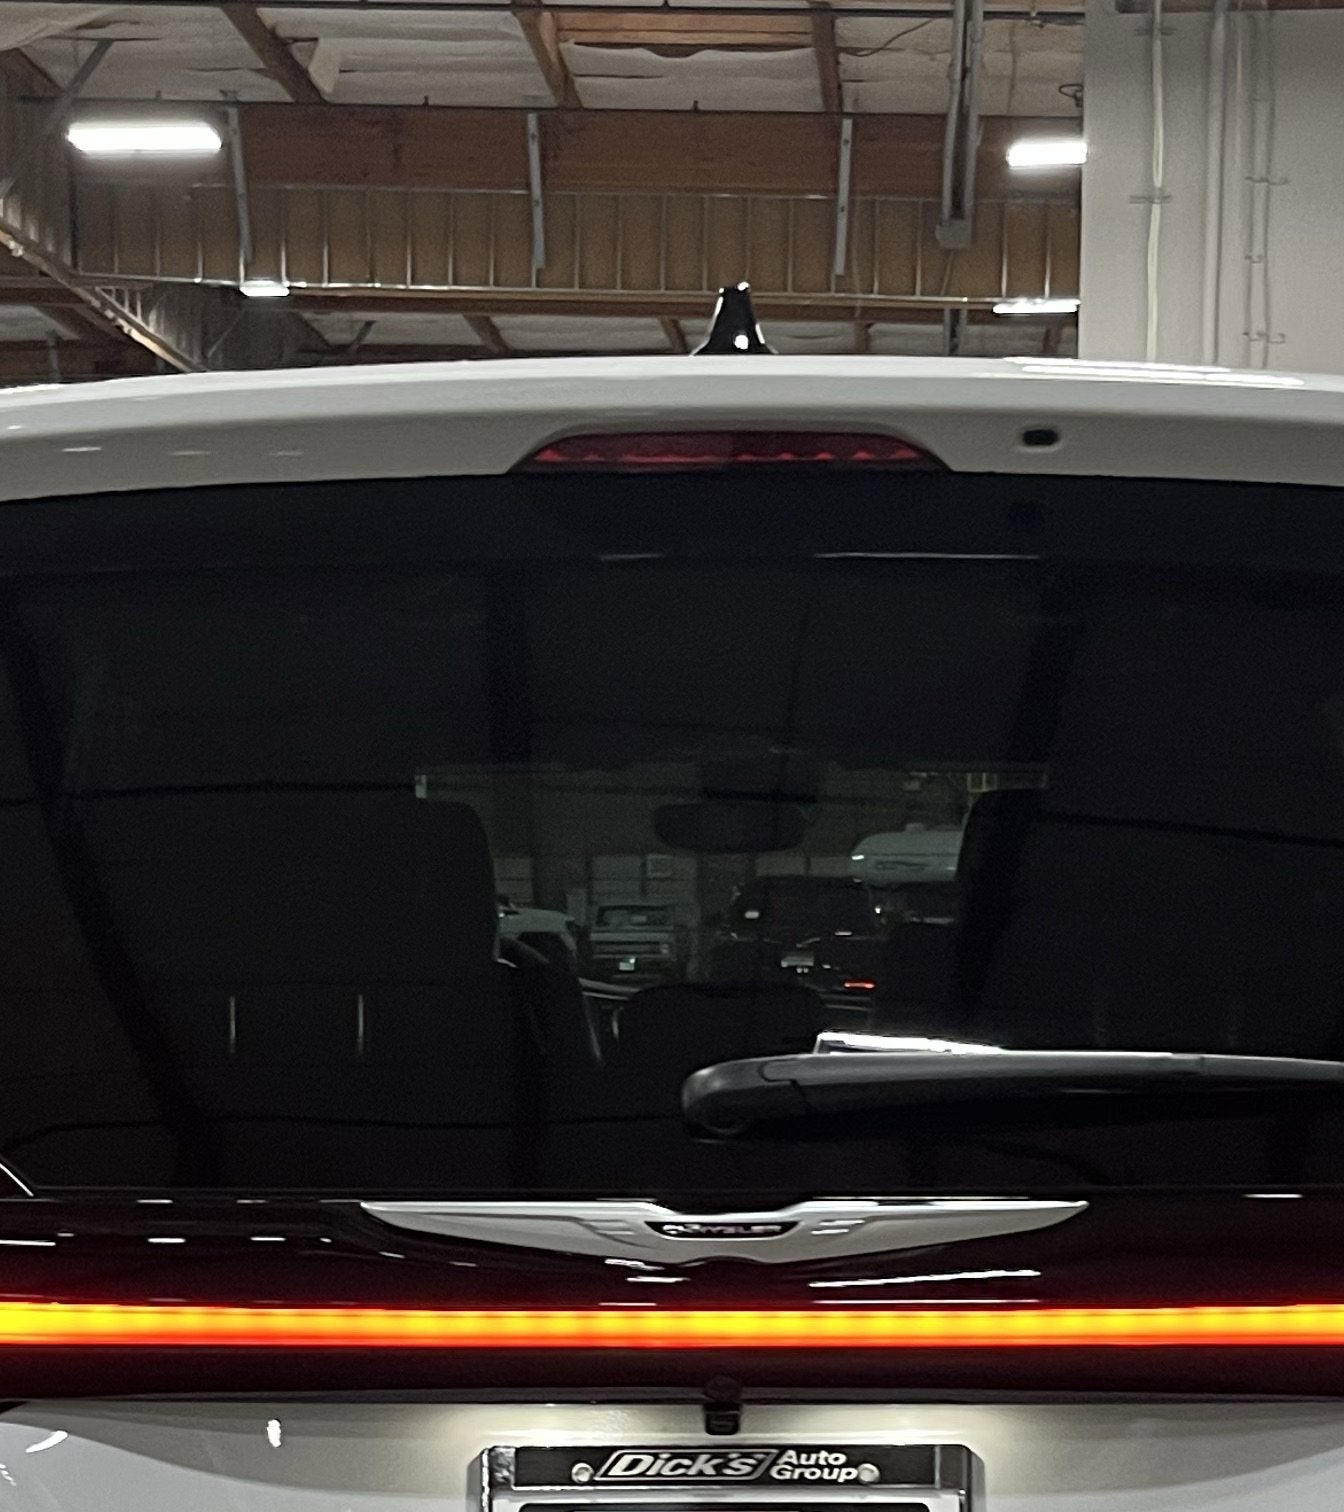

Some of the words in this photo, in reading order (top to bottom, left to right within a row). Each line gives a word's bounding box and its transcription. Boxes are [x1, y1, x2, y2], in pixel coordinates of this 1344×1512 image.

[607, 1453, 758, 1477] Dick's
[777, 1450, 847, 1466] Auto
[769, 1464, 857, 1483] Group
